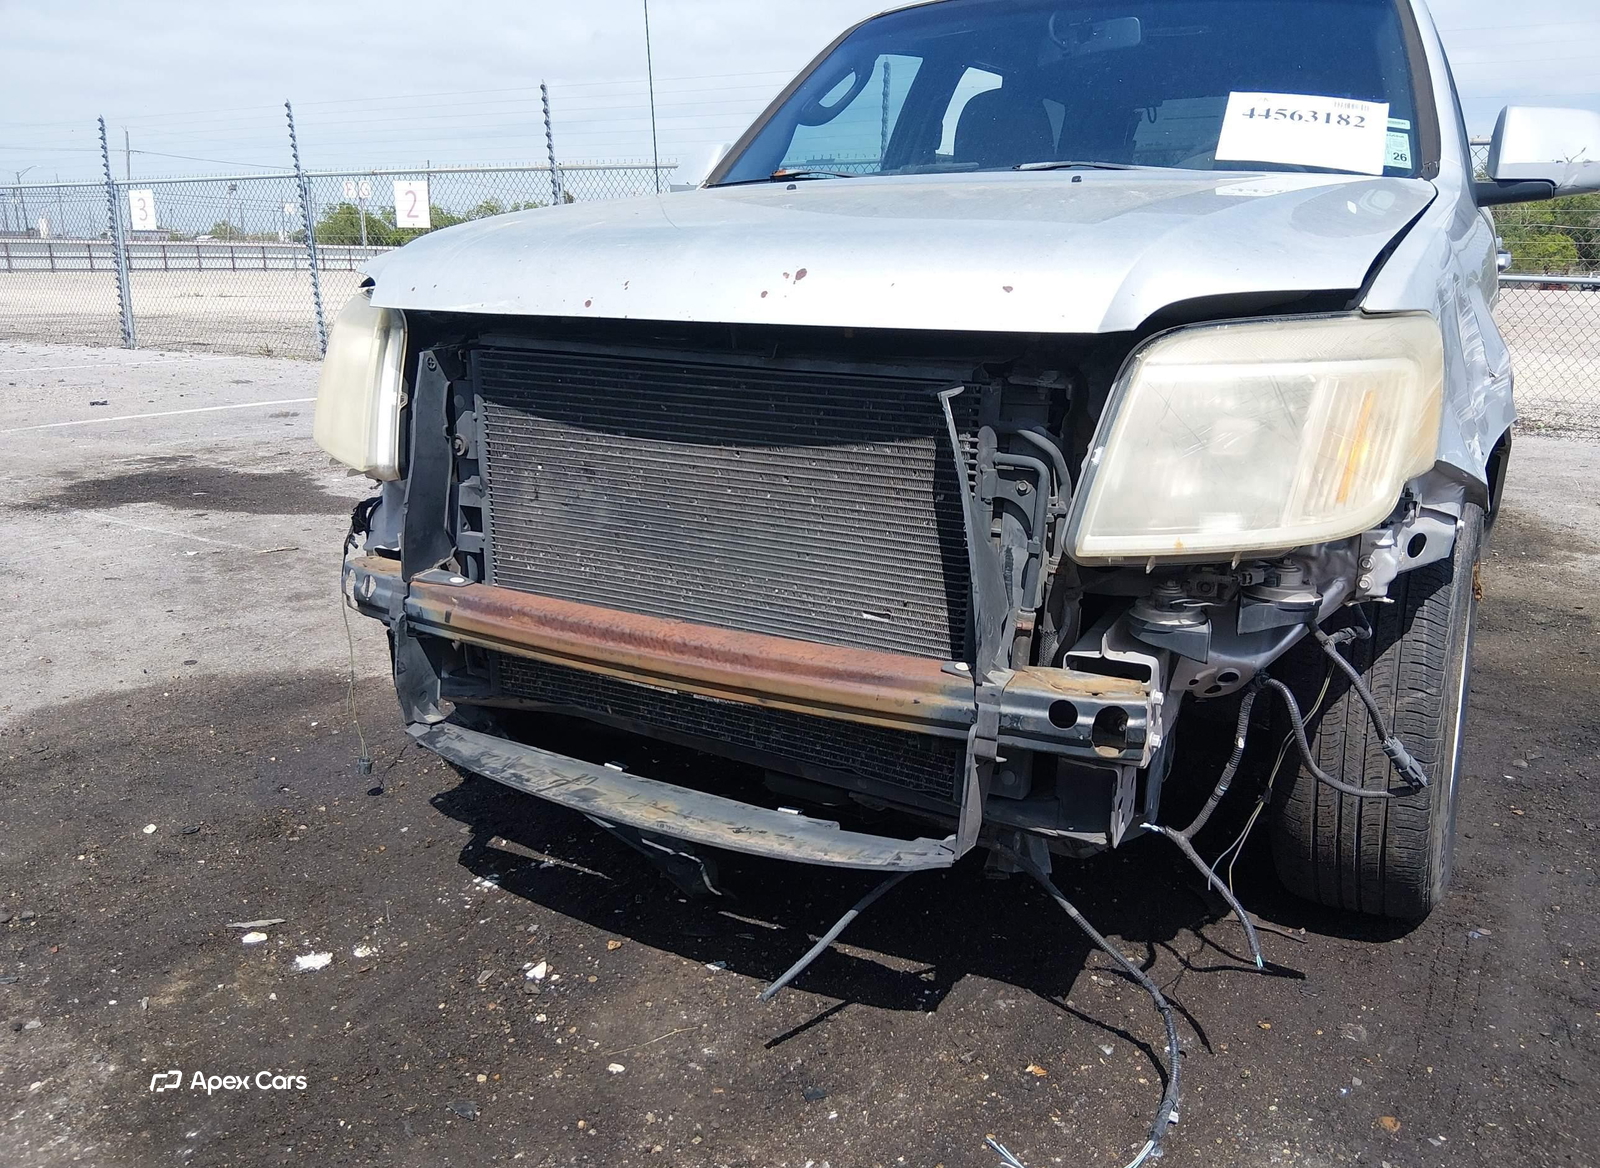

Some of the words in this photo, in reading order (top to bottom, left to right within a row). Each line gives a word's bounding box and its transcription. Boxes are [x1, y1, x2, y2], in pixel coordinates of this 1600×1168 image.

[1242, 106, 1366, 128] 44563182
[1393, 151, 1407, 162] 26
[137, 197, 148, 222] 3
[405, 190, 419, 219] 2
